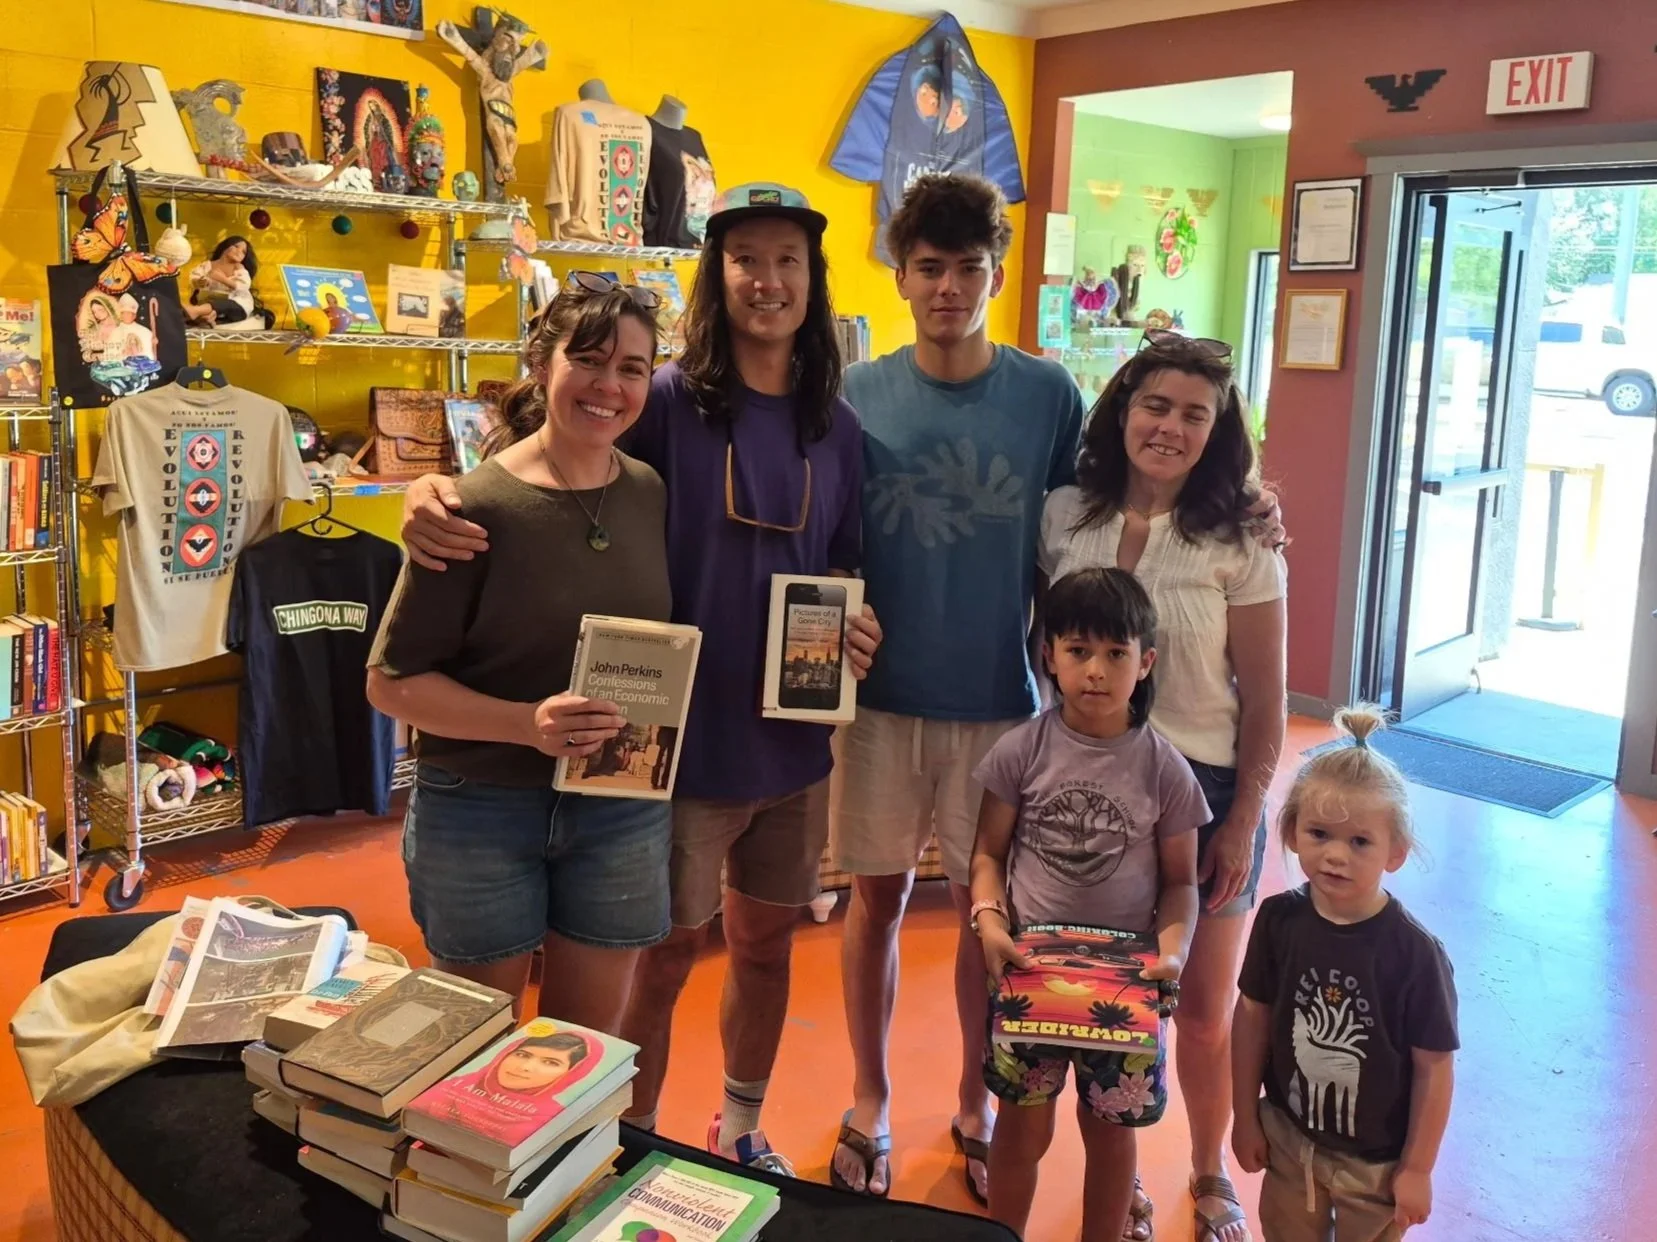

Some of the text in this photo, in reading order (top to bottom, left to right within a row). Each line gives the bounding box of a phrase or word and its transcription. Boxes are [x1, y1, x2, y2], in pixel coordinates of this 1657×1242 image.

[1506, 56, 1573, 106] EXIT
[6, 311, 34, 321] Me!
[160, 428, 178, 573] EVOLUTION
[223, 430, 245, 566] REVOLUTION
[278, 605, 366, 628] CHINGONA WAY
[793, 608, 821, 617] Pictures
[798, 617, 831, 627] Gone City
[590, 661, 663, 679] John Perkins
[587, 673, 657, 692] Confessions
[599, 690, 615, 700] an
[614, 688, 670, 705] Economic
[1059, 780, 1104, 790] FOREST
[1027, 924, 1137, 939] COLORING BOOK
[1295, 967, 1320, 1006] REI
[1001, 1020, 1150, 1044] LOWRIDER
[451, 1078, 463, 1087] I
[463, 1082, 487, 1098] Am
[490, 1092, 538, 1114] Malala
[628, 1187, 727, 1232] COMMUNICATION
[639, 1179, 736, 1218] Nonviolent
